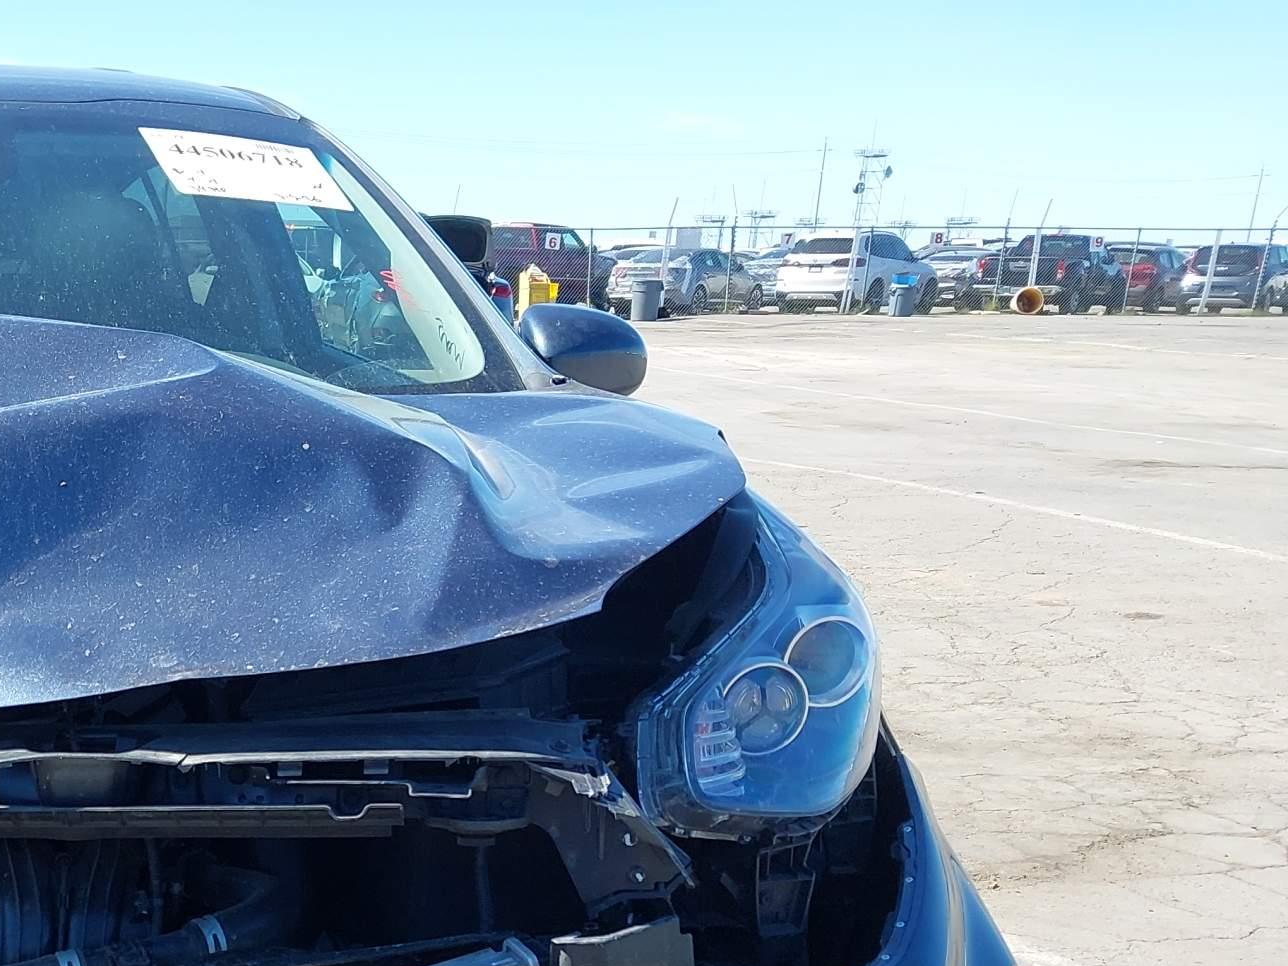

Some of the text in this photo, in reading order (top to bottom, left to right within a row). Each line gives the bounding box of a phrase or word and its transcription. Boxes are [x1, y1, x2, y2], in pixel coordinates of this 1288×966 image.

[168, 143, 303, 169] 44506718
[548, 236, 558, 249] 6
[784, 233, 792, 245] 7
[934, 232, 944, 244] 8
[1095, 236, 1104, 248] 9
